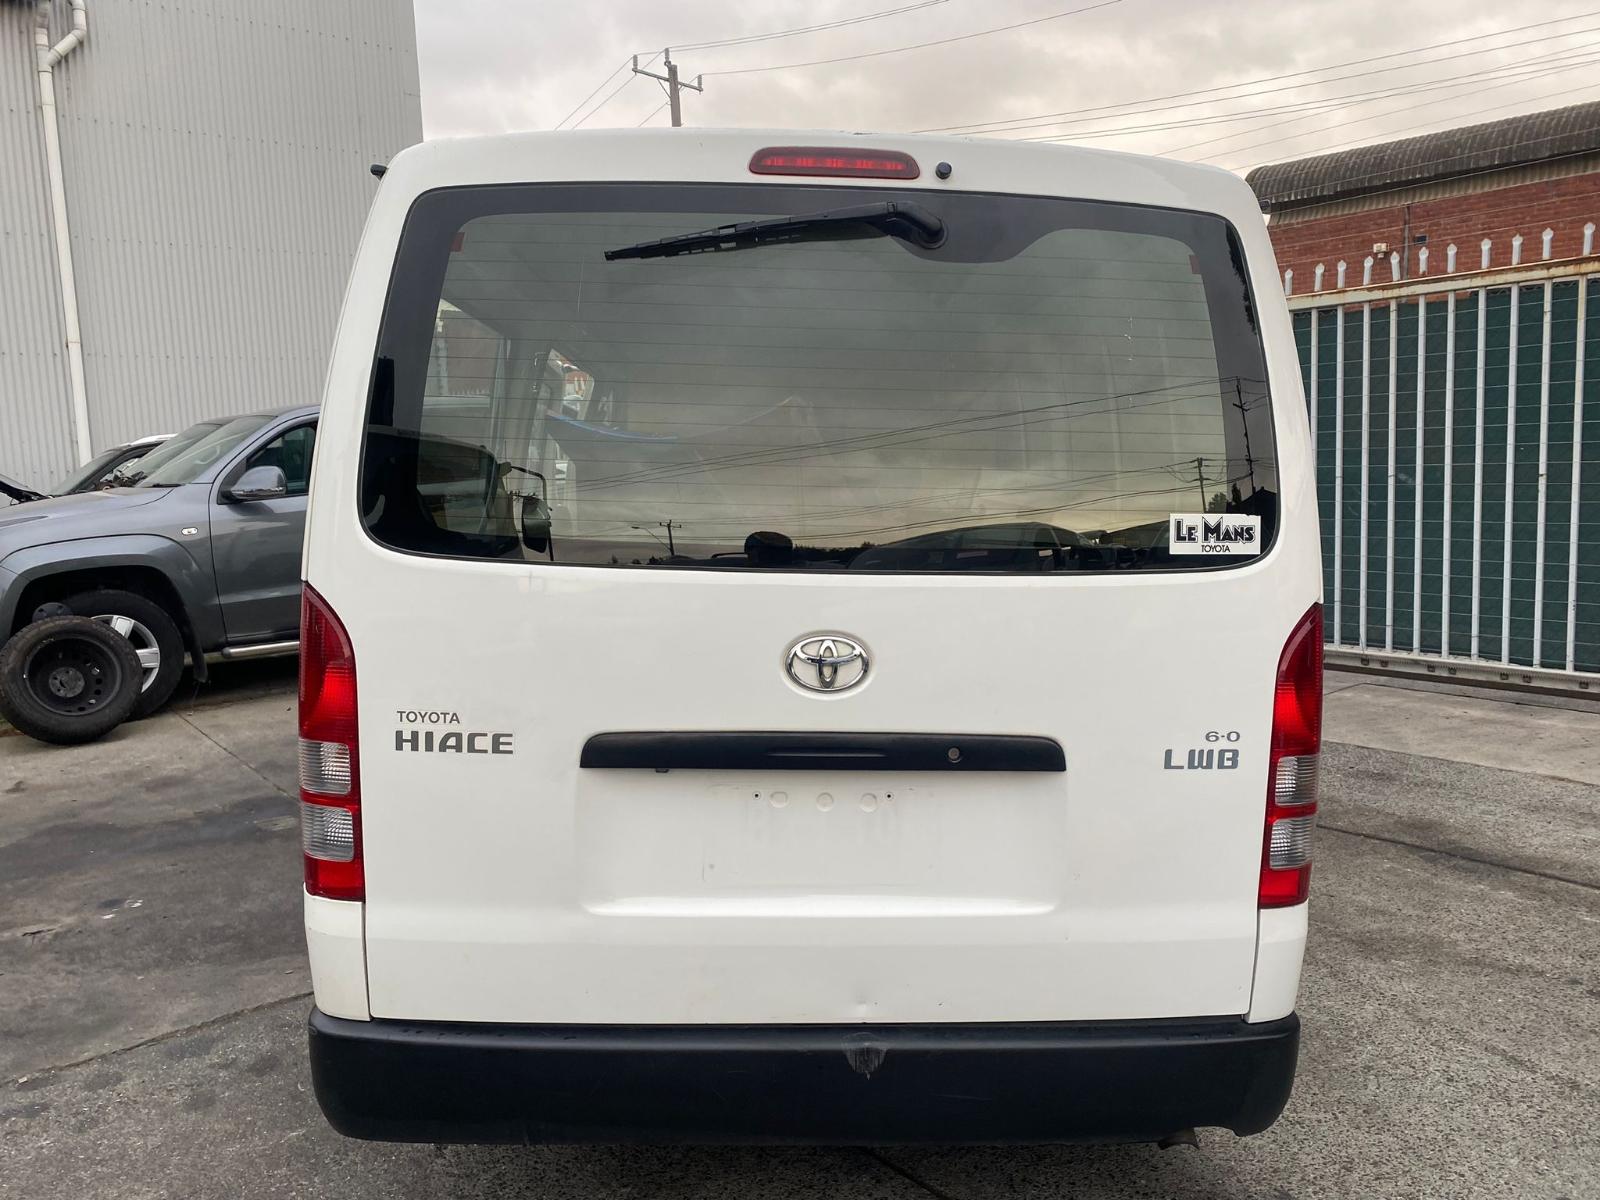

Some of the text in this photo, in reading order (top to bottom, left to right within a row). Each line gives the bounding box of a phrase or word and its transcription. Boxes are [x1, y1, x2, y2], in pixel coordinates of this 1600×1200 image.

[397, 711, 460, 724] TOYOTA
[395, 730, 513, 754] HIACE
[1164, 749, 1239, 769] LWB
